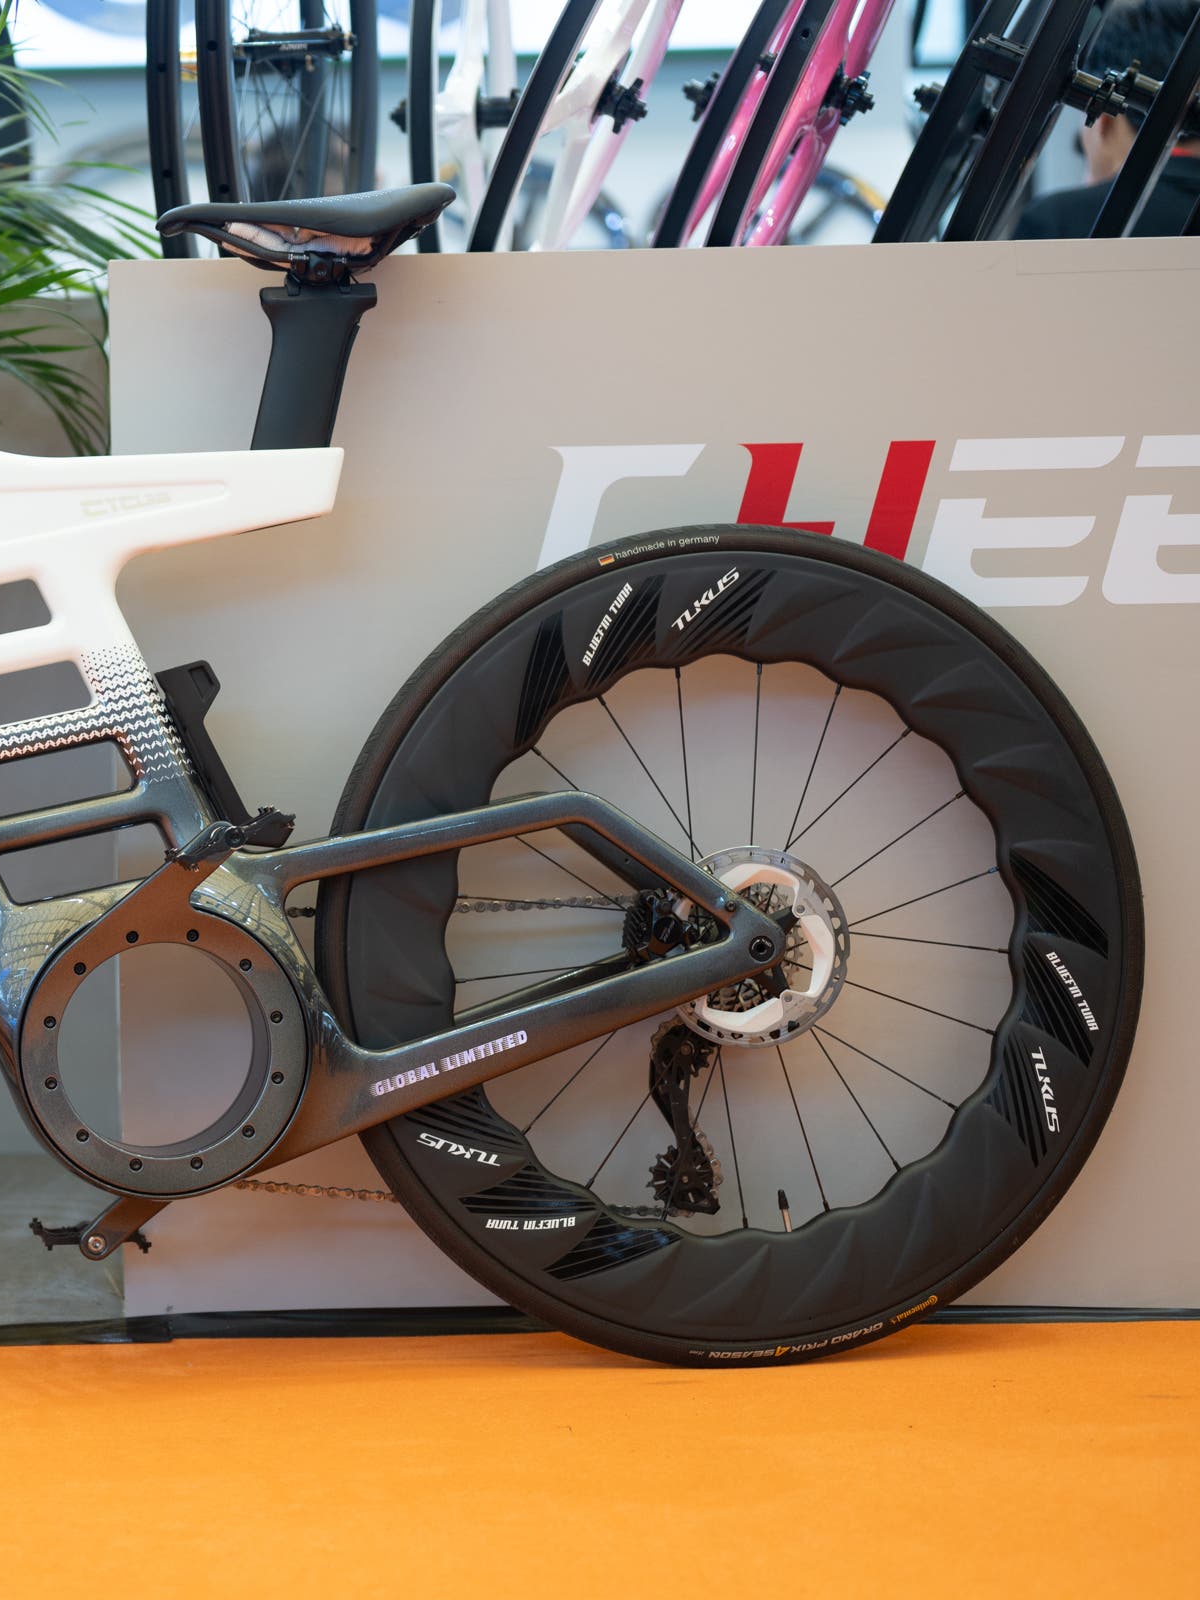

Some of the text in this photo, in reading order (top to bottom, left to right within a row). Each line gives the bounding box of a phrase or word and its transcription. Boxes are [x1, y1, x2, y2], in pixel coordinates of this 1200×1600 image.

[615, 534, 720, 560] handmade in germany
[582, 582, 633, 667] BLUEFIN TUNA
[1045, 951, 1100, 1031] BLUEFIN TUNA
[369, 1030, 528, 1097] GLOBAL LIMTITED
[485, 1216, 577, 1231] BLUEFIN TUNA
[896, 1295, 938, 1323] Continental
[831, 1321, 883, 1344] GRAND
